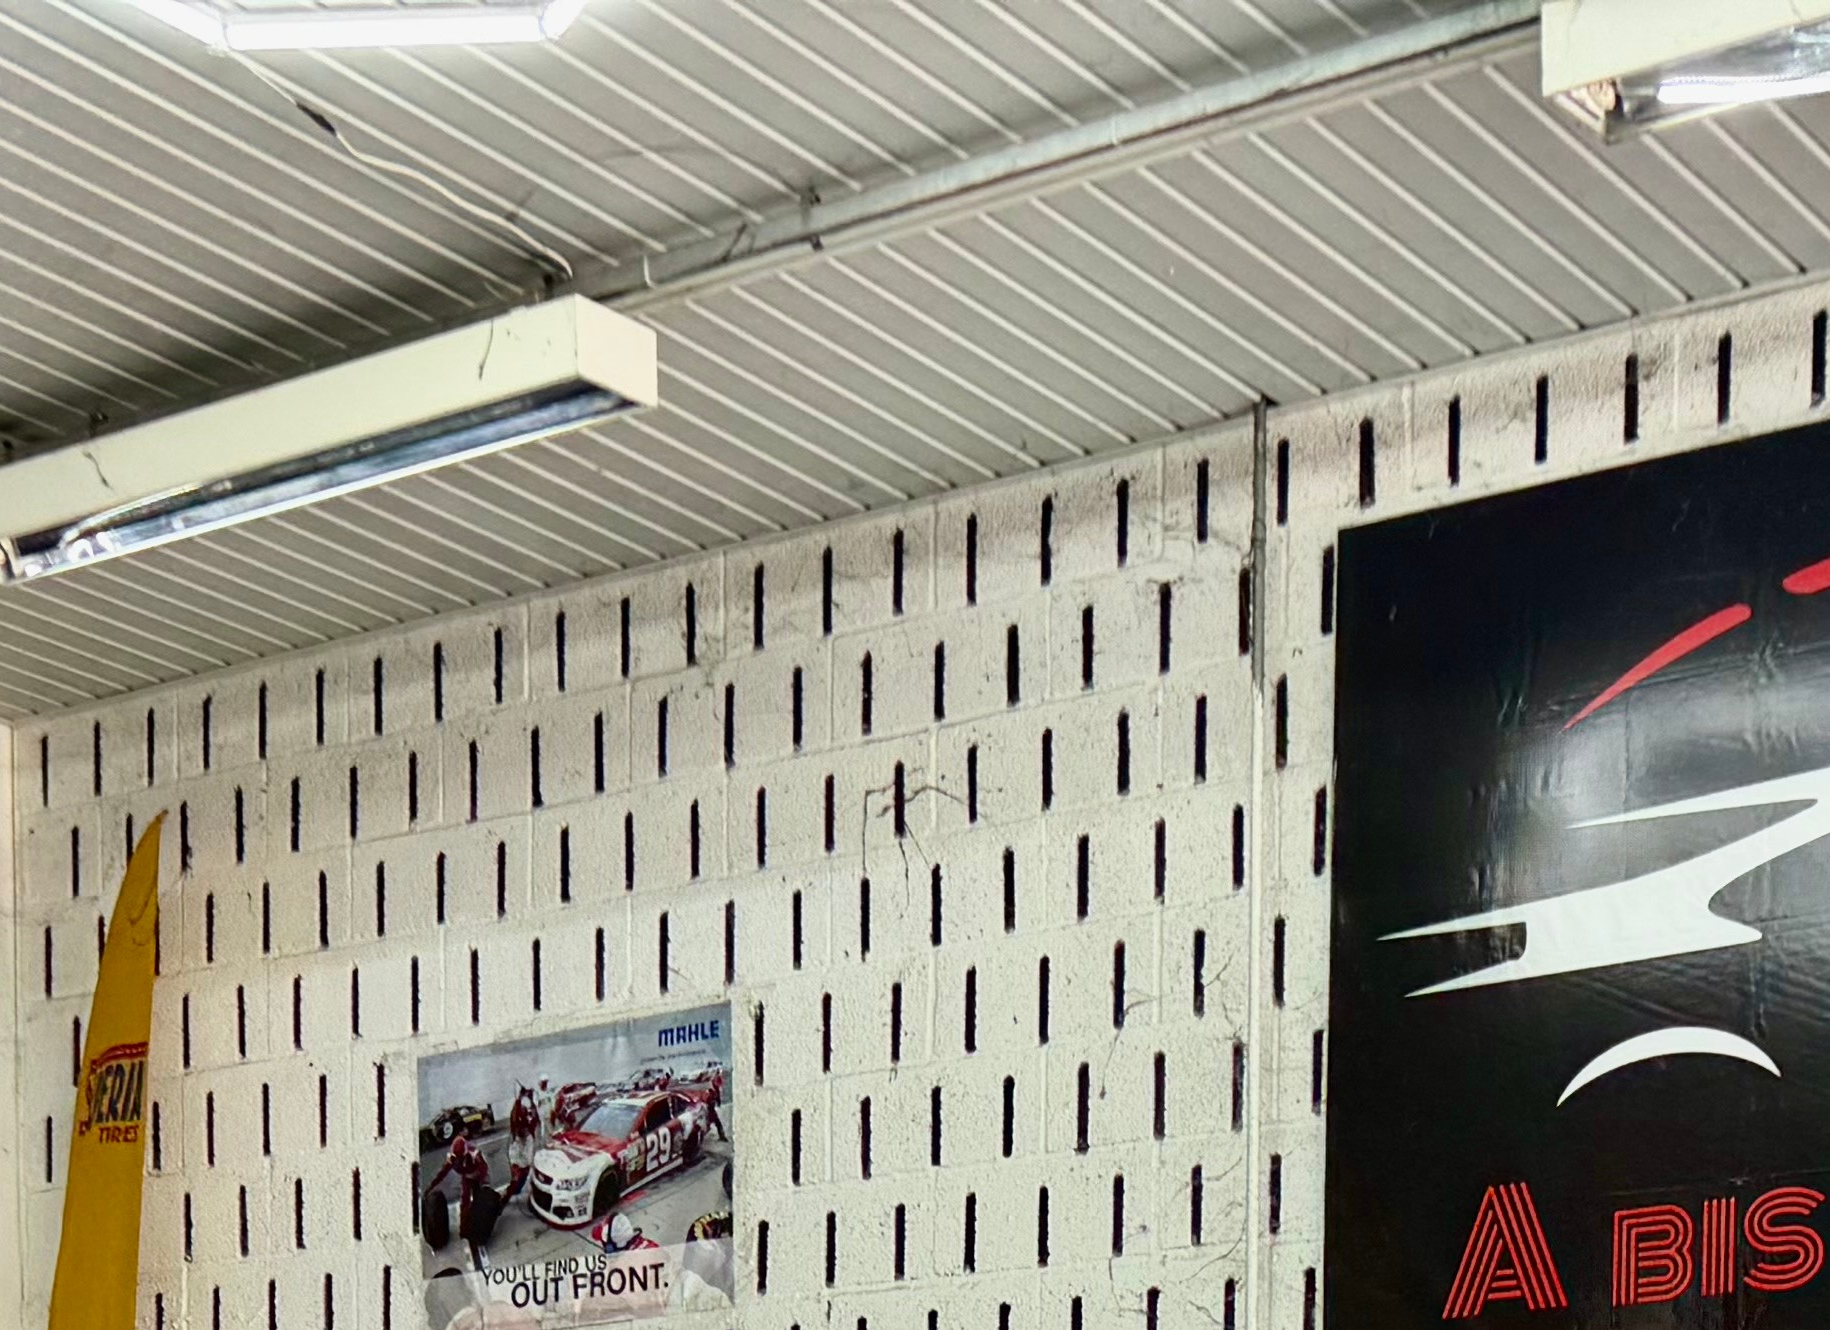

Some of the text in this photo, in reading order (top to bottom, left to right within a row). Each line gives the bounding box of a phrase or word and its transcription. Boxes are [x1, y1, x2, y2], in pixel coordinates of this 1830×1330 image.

[658, 1019, 720, 1048] MAHLE
[646, 1126, 671, 1173] 29
[482, 1253, 607, 1286] YOU'LL FIND US
[1442, 1181, 1568, 1319] A
[1612, 1186, 1826, 1307] BIS
[511, 1262, 669, 1309] OUT FRONT.
